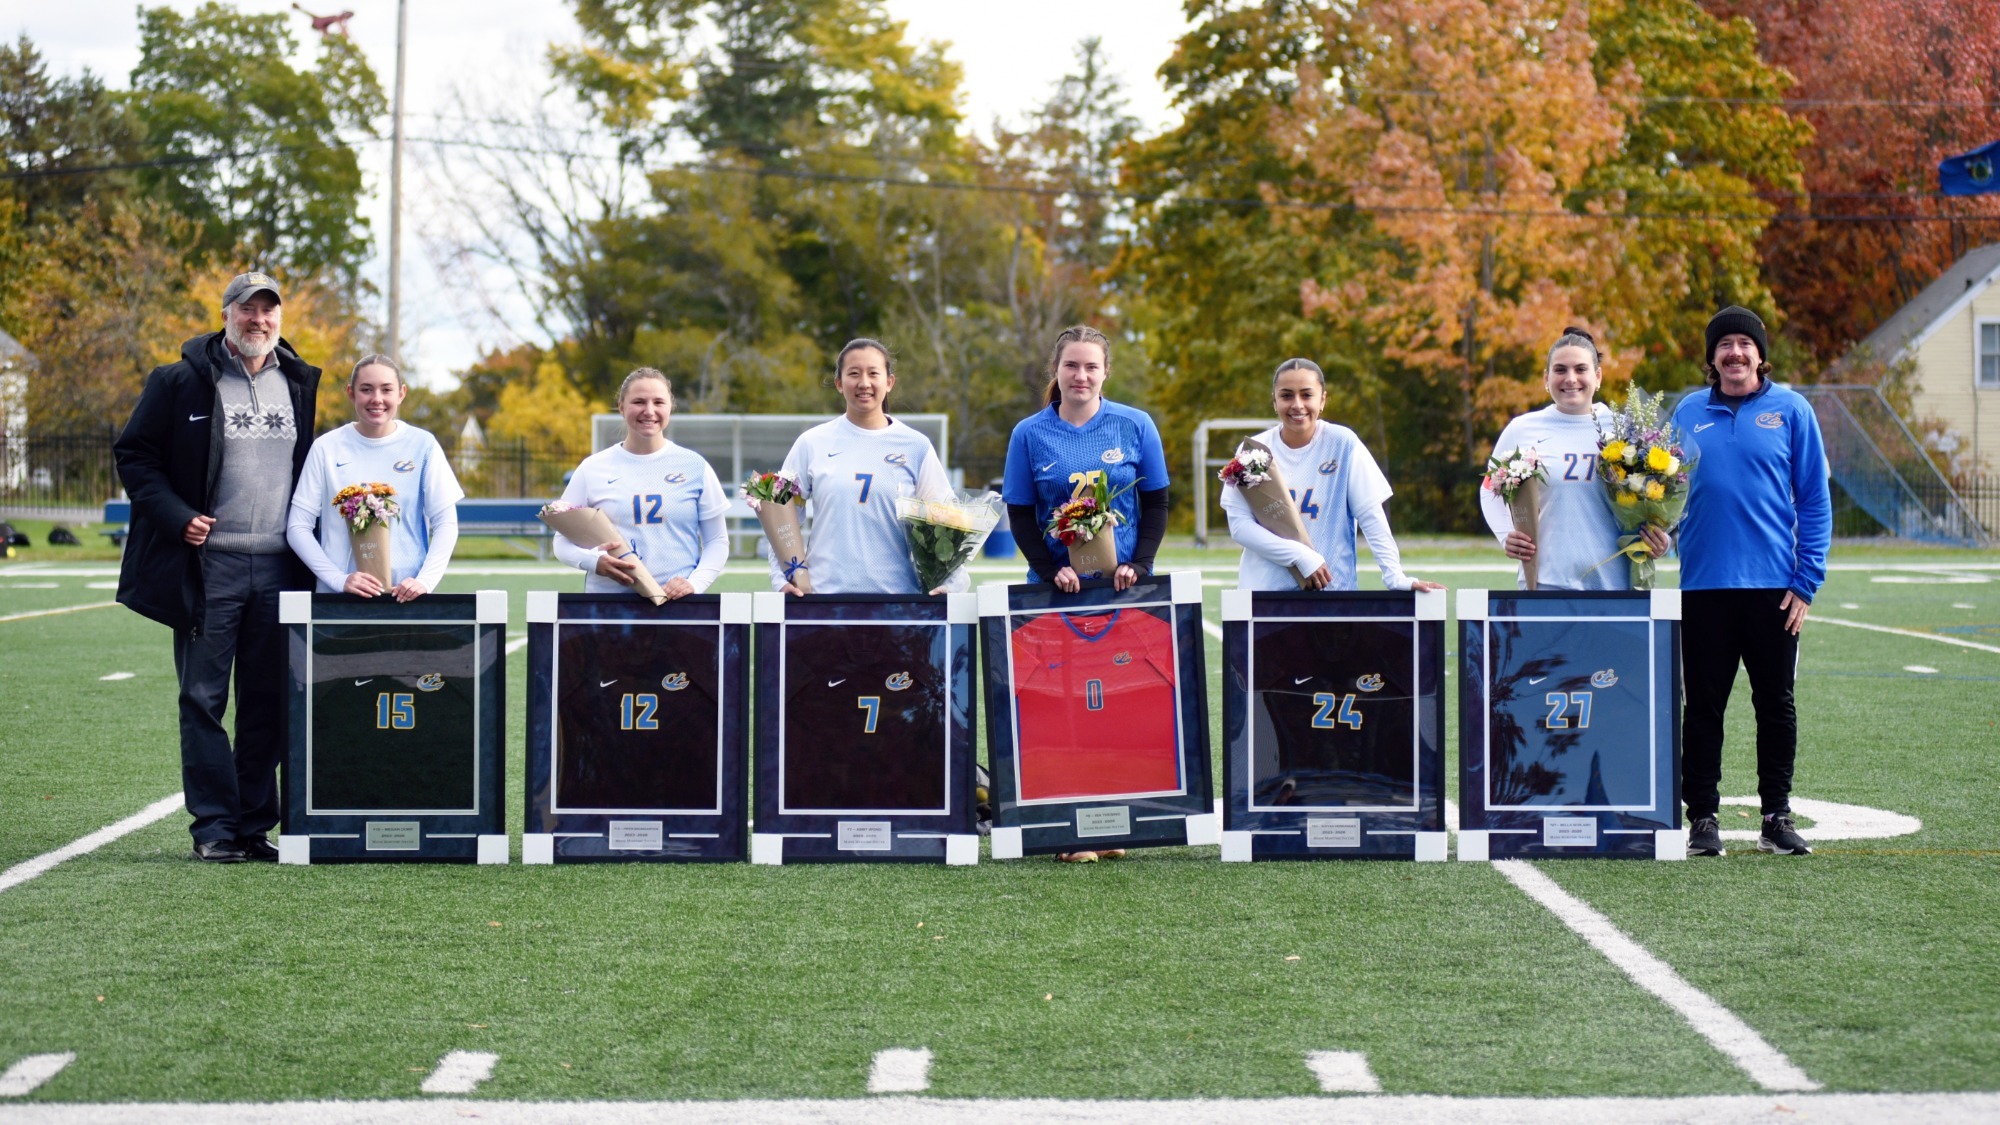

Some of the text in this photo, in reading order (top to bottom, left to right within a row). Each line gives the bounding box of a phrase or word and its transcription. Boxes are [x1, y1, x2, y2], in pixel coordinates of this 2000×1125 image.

[1563, 452, 1597, 482] 27
[855, 472, 874, 505] 7
[1288, 488, 1320, 520] 4
[632, 493, 664, 526] 12
[1080, 555, 1098, 565] ISA
[376, 692, 415, 730] 15
[1086, 678, 1104, 711] 0
[1311, 692, 1363, 730] 24
[1545, 691, 1593, 729] 27
[620, 693, 659, 730] 12
[857, 696, 881, 733] 7
